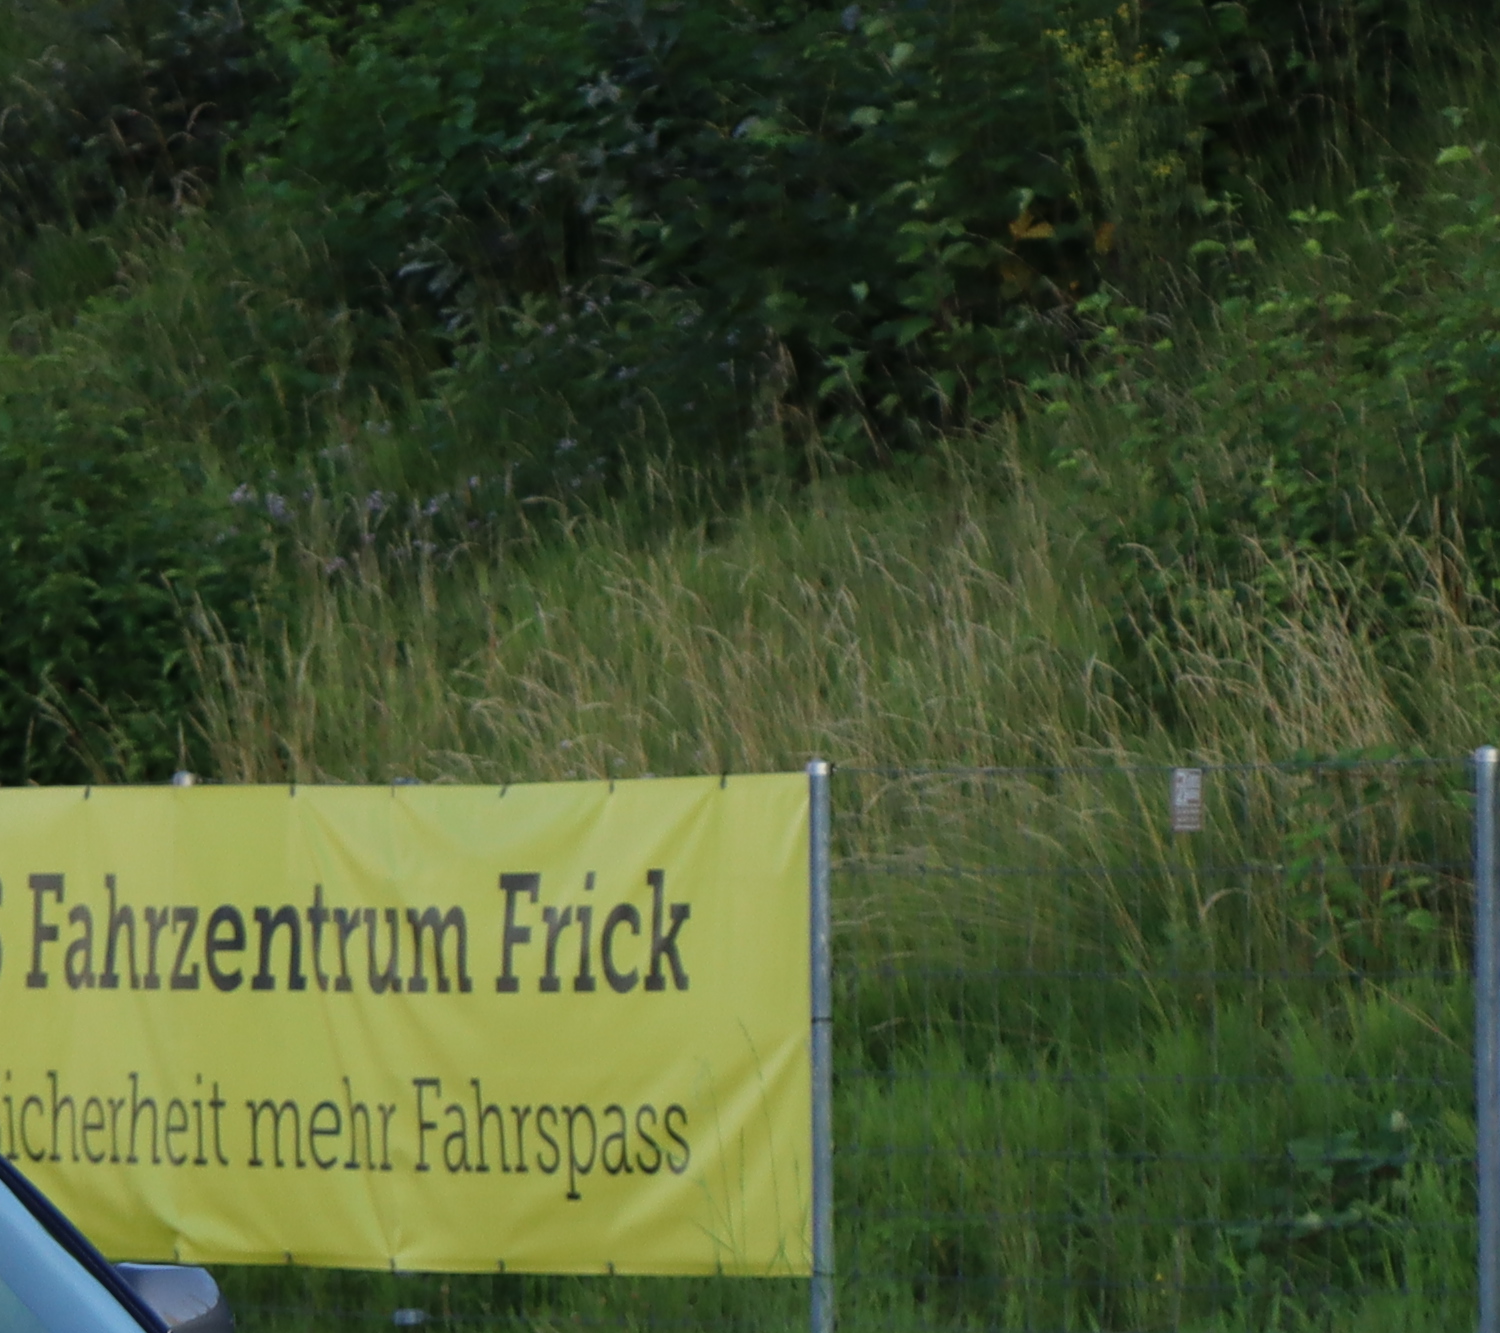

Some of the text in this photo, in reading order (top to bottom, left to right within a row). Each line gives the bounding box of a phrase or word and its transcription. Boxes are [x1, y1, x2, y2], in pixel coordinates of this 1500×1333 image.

[25, 872, 473, 994] Fahrzentrum
[495, 868, 692, 994] Frick
[246, 1076, 396, 1171] mehr
[412, 1077, 691, 1200] Fahrspass
